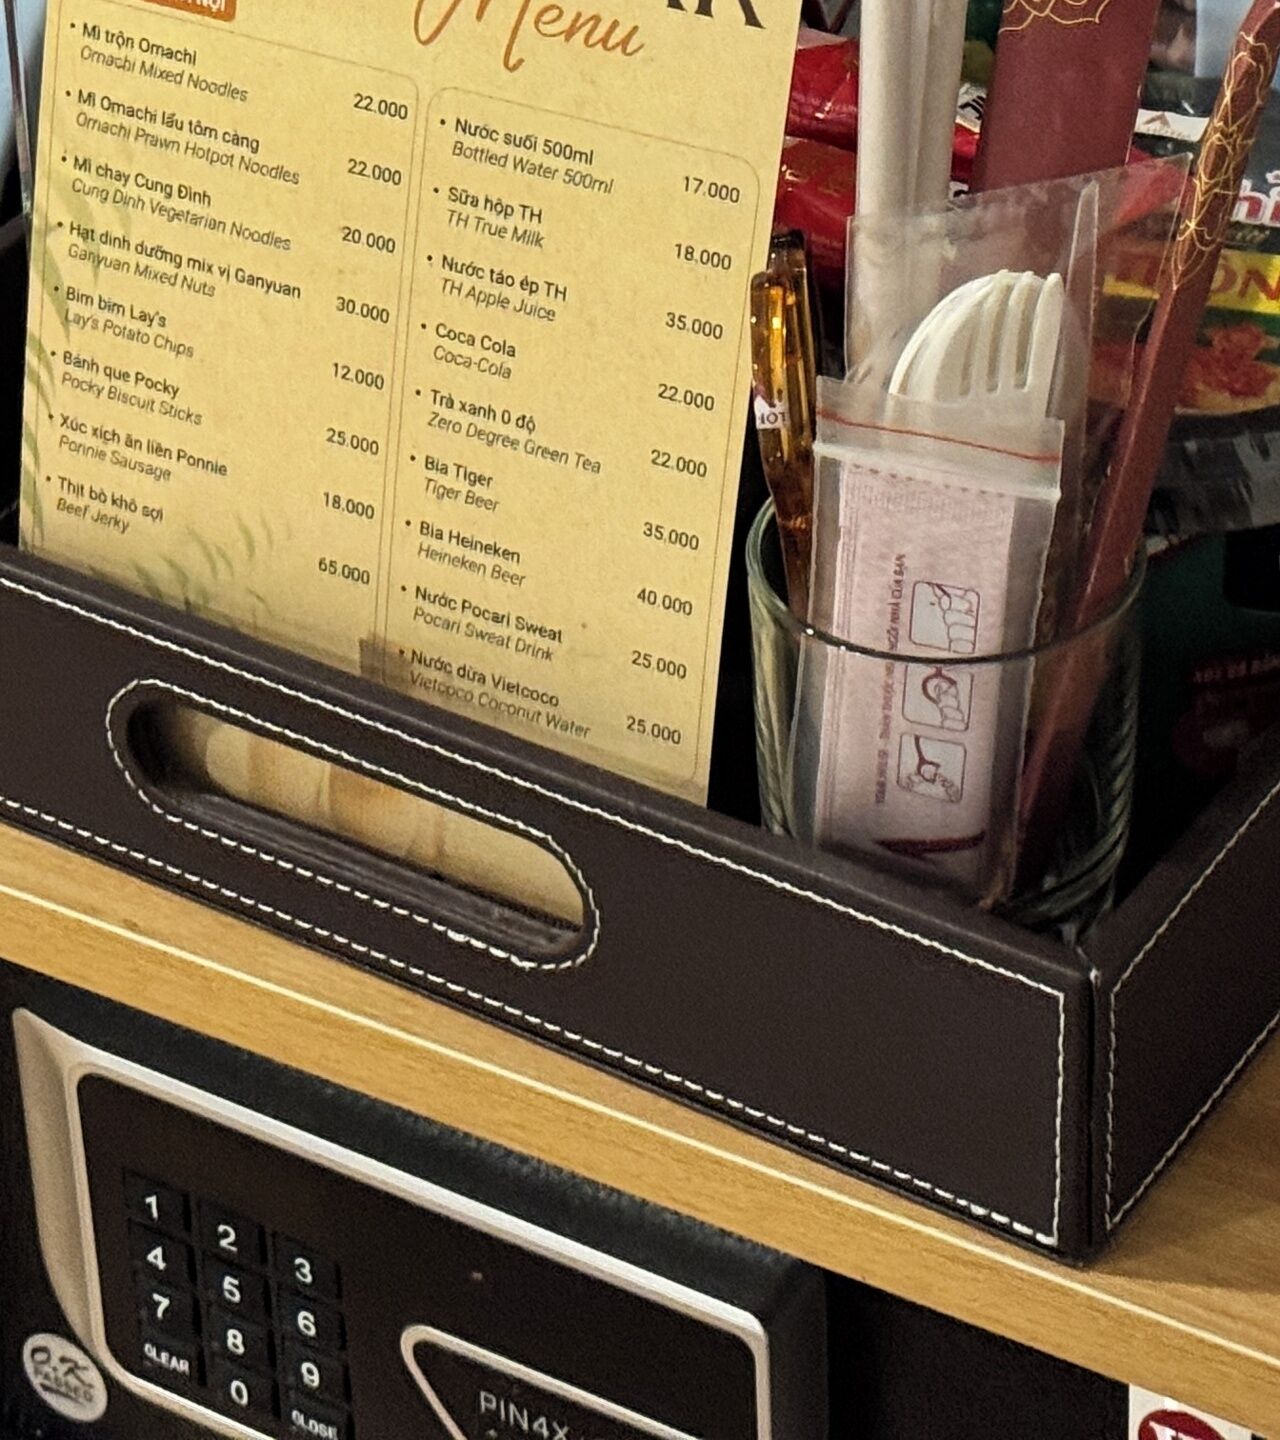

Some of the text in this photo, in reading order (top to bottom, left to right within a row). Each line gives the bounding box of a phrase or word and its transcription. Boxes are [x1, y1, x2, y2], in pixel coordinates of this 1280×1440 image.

[105, 29, 197, 67] trộn Omachi
[139, 61, 183, 86] Mixed
[187, 73, 248, 102] Noodles
[353, 93, 409, 120] 22.000
[100, 96, 260, 154] Omachi tôm càng
[134, 127, 180, 154] Prawn
[183, 139, 235, 168] Hotpot
[238, 155, 300, 186] Noodles
[542, 138, 595, 167] 500ml
[95, 162, 212, 206] chay Cung Đình
[347, 158, 402, 187] 22.000
[451, 140, 615, 197] Bottled Water 500ml
[683, 175, 741, 204] 17.000
[72, 178, 292, 251] Cung Vegetarian Noodles
[446, 208, 470, 230] TH
[473, 216, 509, 240] True
[484, 194, 515, 221] hộp
[519, 204, 544, 225] TH
[341, 226, 396, 253] 20.000
[68, 243, 217, 298] Ganyuan Mixed Nuts
[70, 222, 302, 300] Hạt dinh mix Ganyuan
[674, 242, 732, 272] 18.000
[441, 254, 568, 303] Nước táo ép TH
[335, 296, 390, 324] 30.000
[440, 277, 557, 323] TH Apple Juice
[129, 304, 167, 329] Lay's
[665, 311, 724, 341] 35.000
[103, 319, 194, 359] Potato Chips
[435, 322, 517, 359] Coca Cola
[63, 350, 180, 400] Bánh que Pocky
[332, 362, 385, 391] 12.000
[433, 344, 513, 380] Coca-Cola
[62, 372, 106, 400] Pocky
[107, 386, 156, 413] Biscuit
[657, 382, 716, 412] 22.000
[430, 388, 537, 435] Trà xanh độ
[326, 427, 380, 456] 25.000
[426, 411, 602, 475] Zero Degree Green Tea
[110, 448, 172, 482] Sausage
[176, 449, 228, 478] Ponnie
[424, 455, 494, 490] Bia Tiger
[650, 448, 708, 479] 22.000
[57, 475, 139, 514] Thịt bò khô
[322, 491, 375, 520] 18.000
[423, 476, 501, 513] Tiger Beer
[57, 497, 130, 535] Beef Jerky
[419, 520, 521, 564] Bia Heineken
[642, 521, 700, 551] 35.000
[318, 556, 370, 586] 65.000
[416, 542, 527, 588] Heineken Beer
[414, 584, 564, 644] Nước Pocari Sweat
[637, 587, 694, 617] 40.000
[412, 606, 556, 663] Pocari Sweat Drink
[631, 650, 688, 679] 25.000
[490, 672, 560, 709] Vietcoco
[477, 690, 543, 723] Coconut
[545, 709, 593, 740] Water
[625, 715, 683, 746] 25.000
[145, 1195, 159, 1220] 1
[217, 1224, 239, 1253] 2
[146, 1246, 167, 1271] 4
[294, 1257, 313, 1285] 3
[223, 1276, 242, 1304] 5
[152, 1293, 170, 1320] 7
[297, 1311, 317, 1338] 6
[226, 1328, 246, 1356] 8
[144, 1343, 190, 1375] CLEAR
[300, 1362, 320, 1389] 9
[230, 1380, 249, 1407] 0
